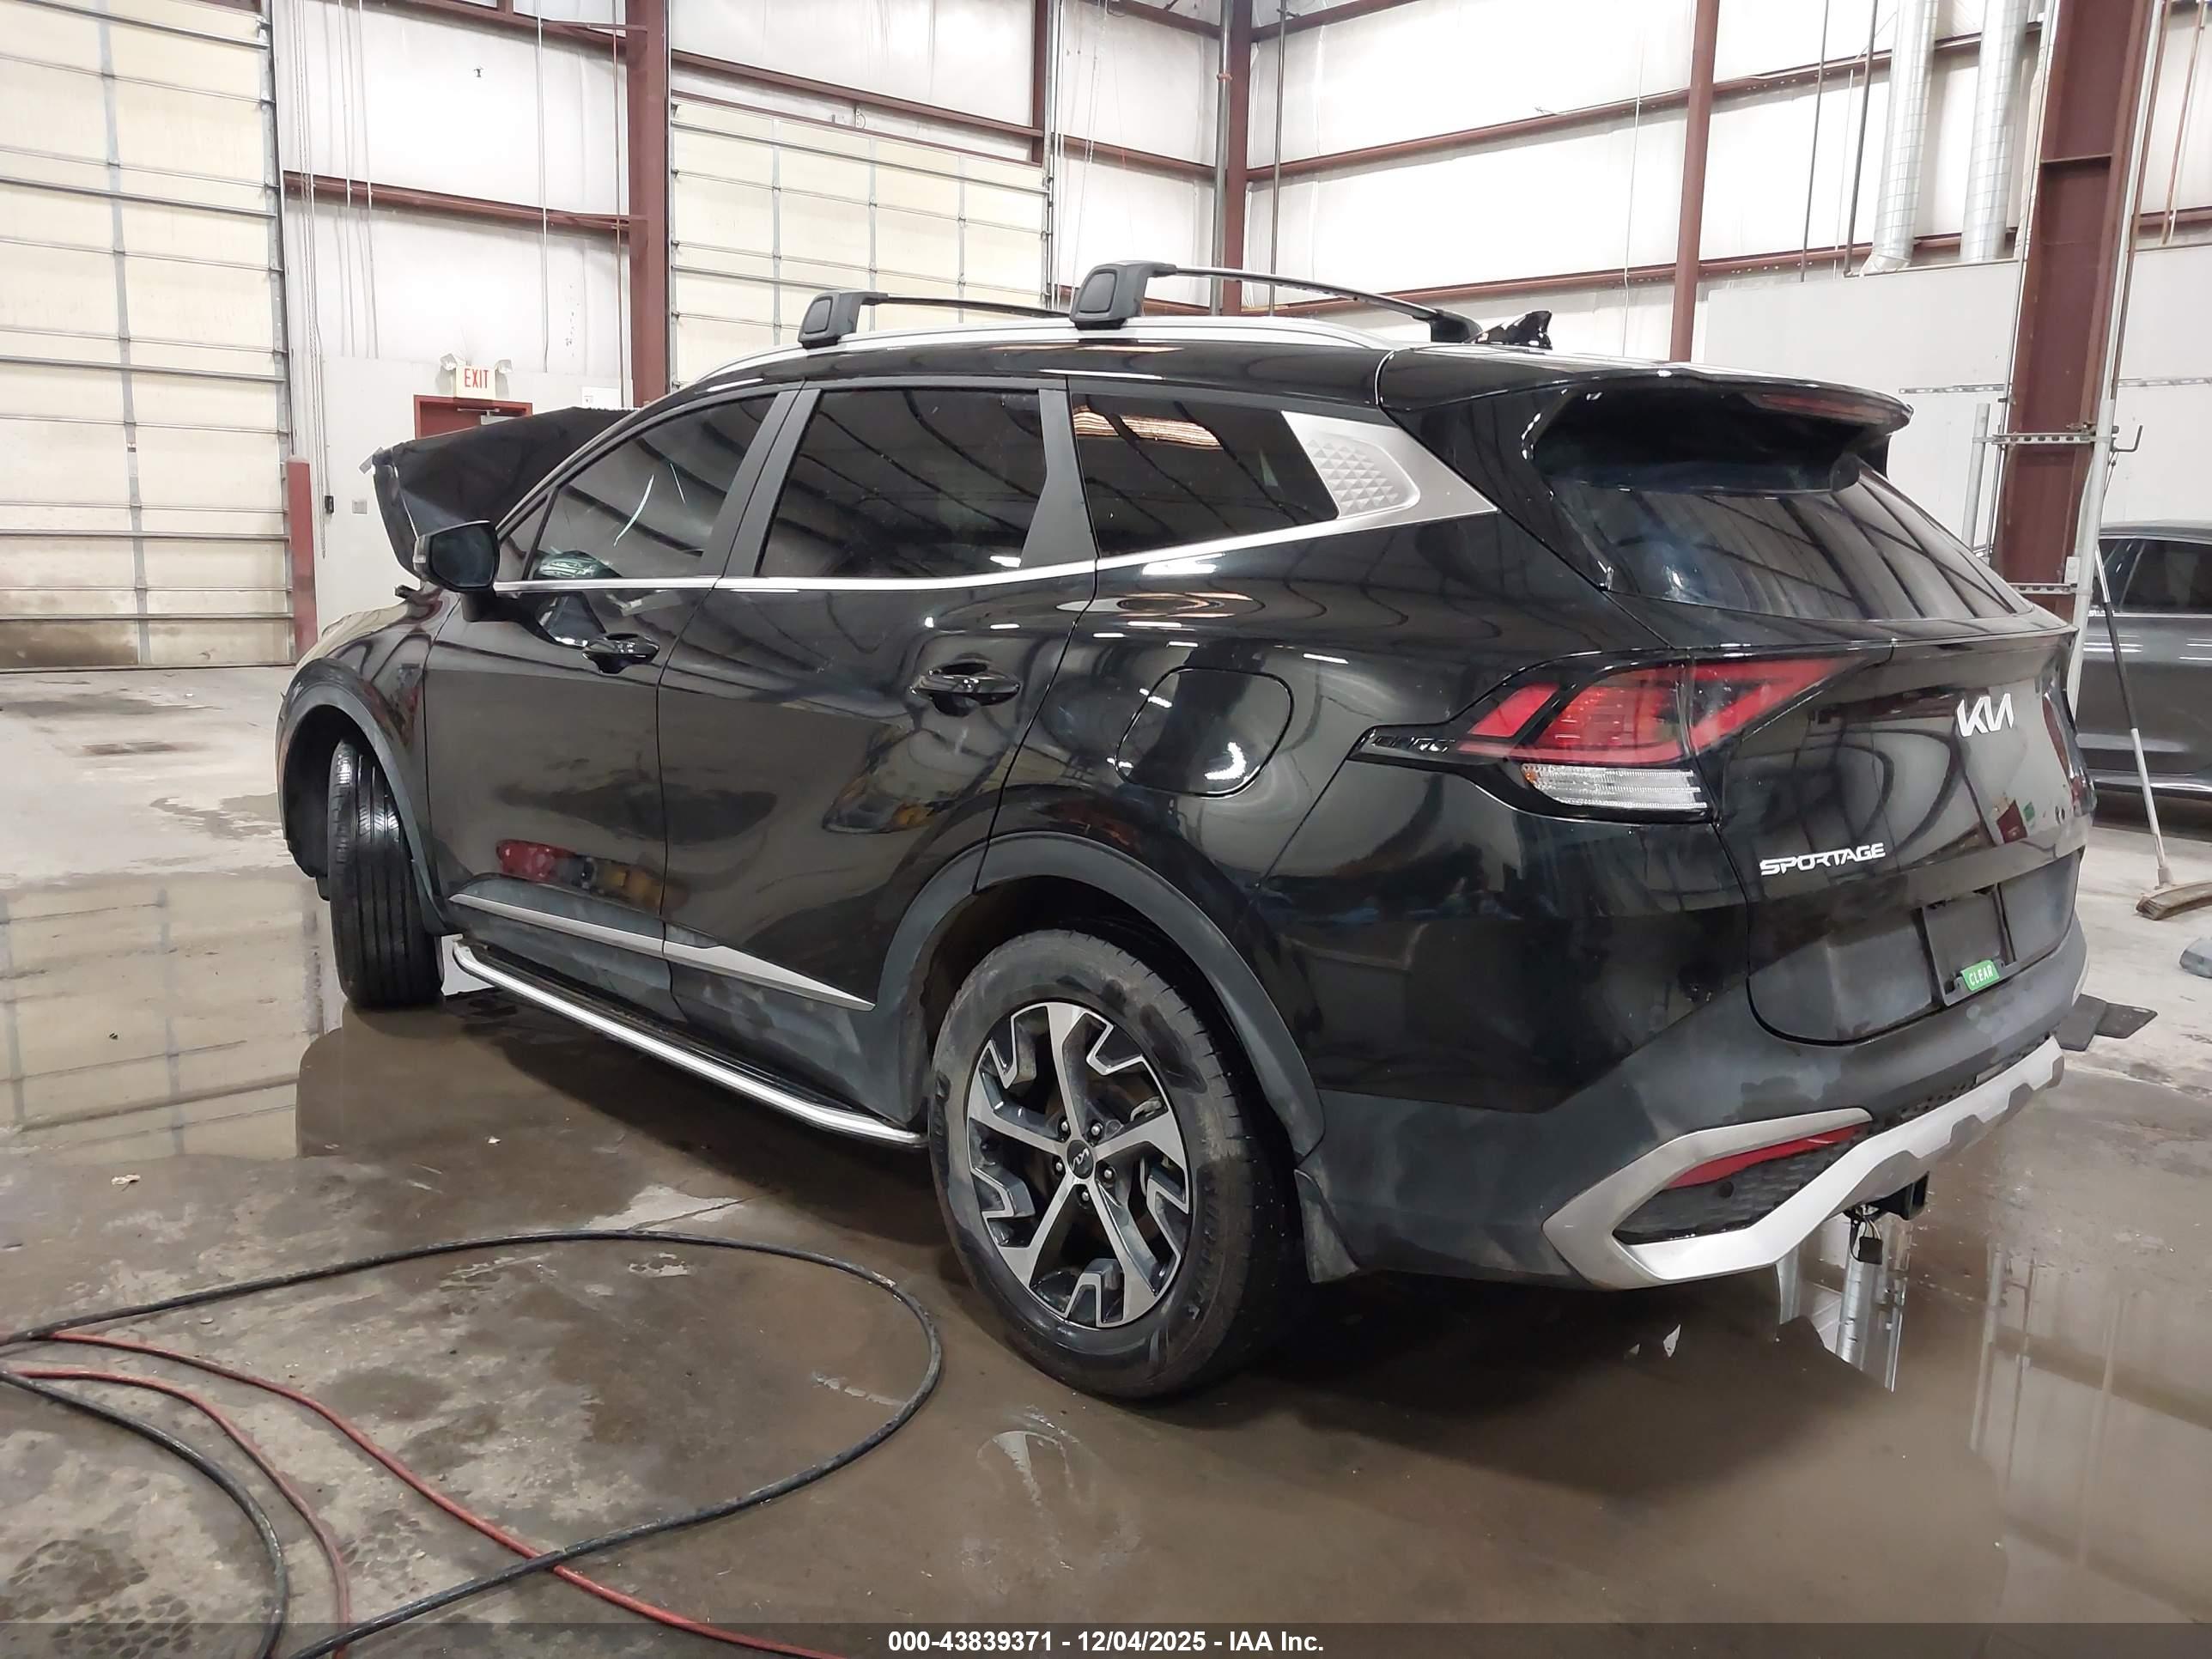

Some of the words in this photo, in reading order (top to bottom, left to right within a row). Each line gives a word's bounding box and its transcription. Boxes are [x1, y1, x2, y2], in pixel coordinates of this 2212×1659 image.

[465, 368, 489, 389] EXIT
[1956, 693, 2014, 738] KIA
[1759, 842, 1887, 876] SPORTAGE
[1968, 963, 1994, 987] CLEAR
